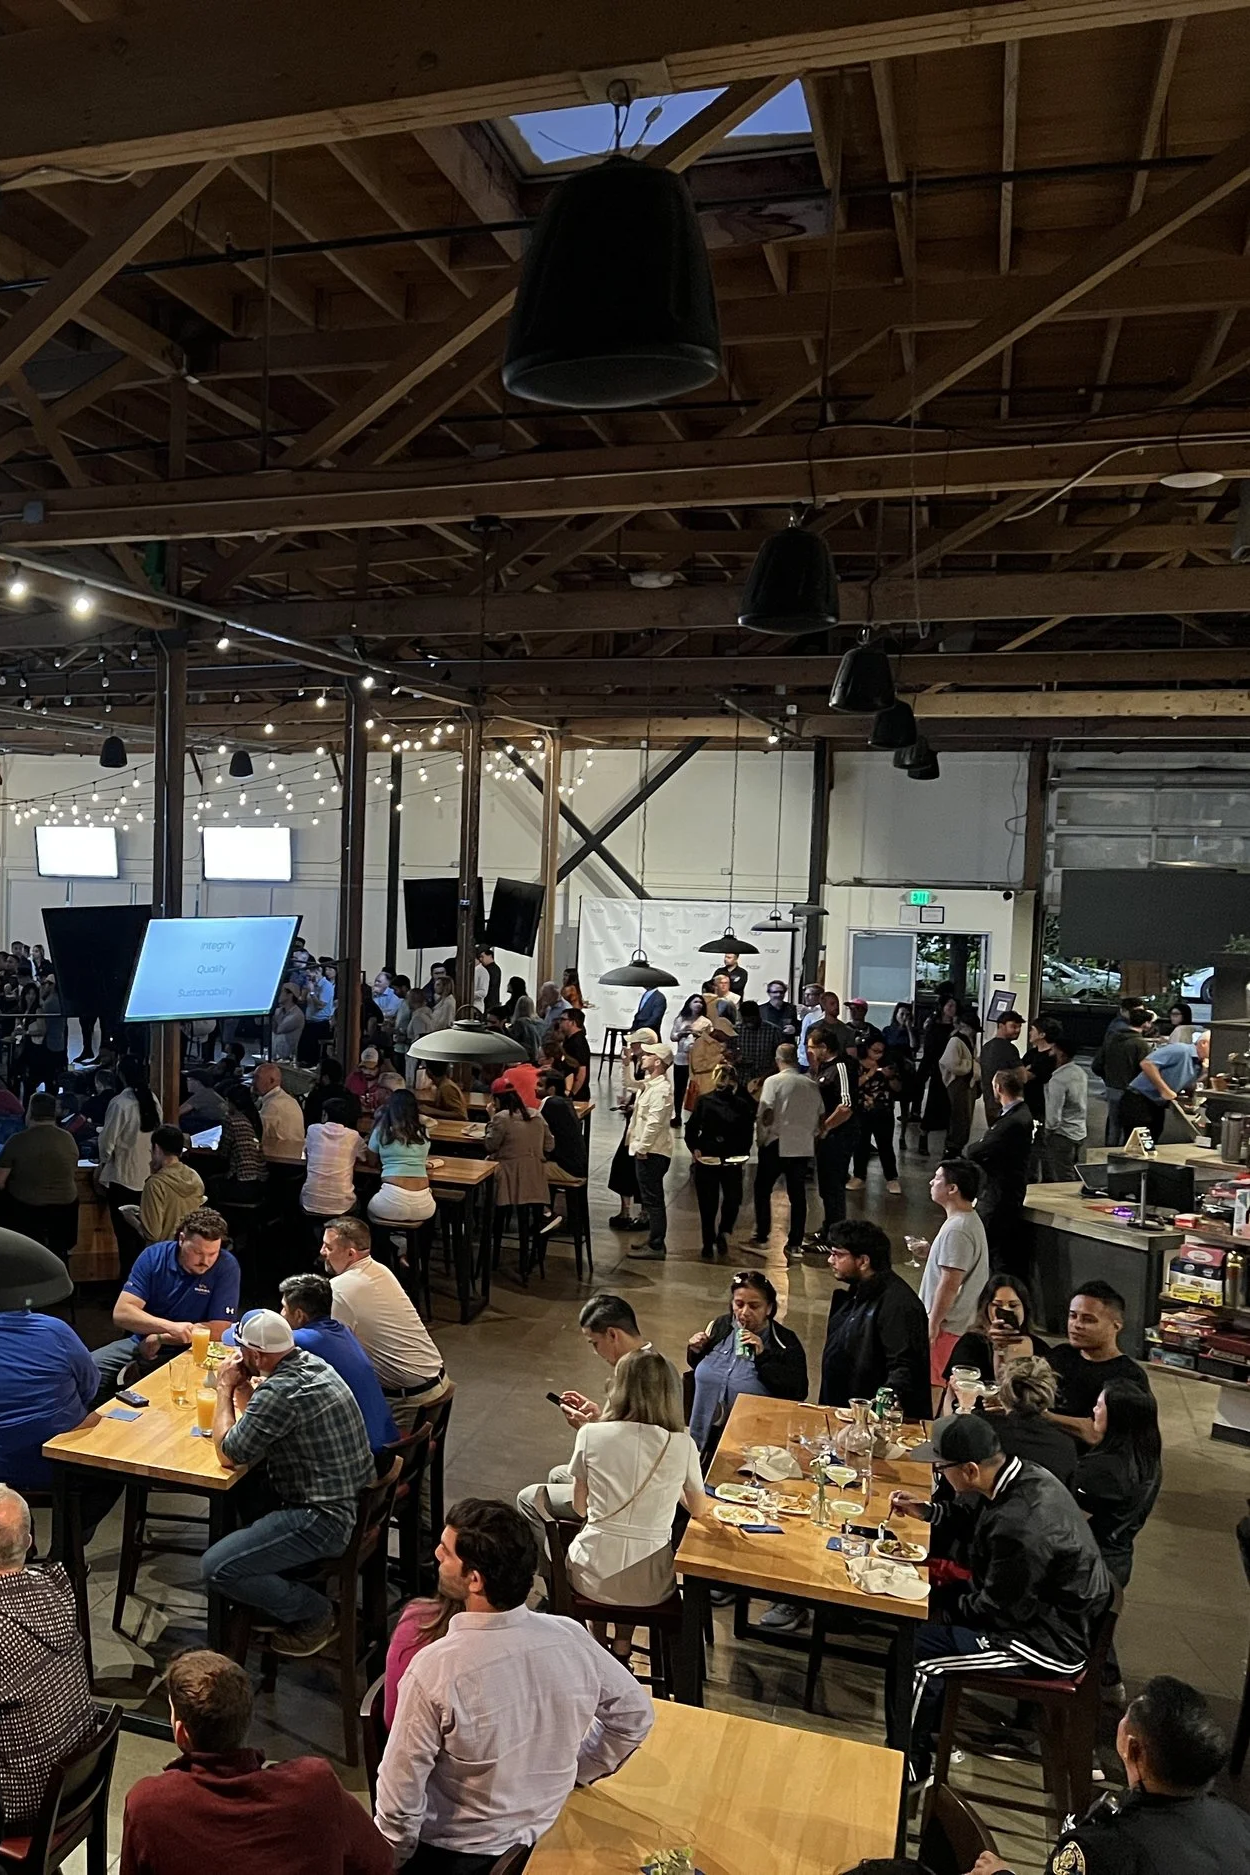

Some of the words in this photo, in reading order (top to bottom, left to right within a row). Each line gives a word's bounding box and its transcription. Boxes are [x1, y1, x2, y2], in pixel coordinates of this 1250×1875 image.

[201, 941, 235, 952] Integrity
[196, 964, 227, 975] Quality
[177, 987, 233, 998] Sustainability
